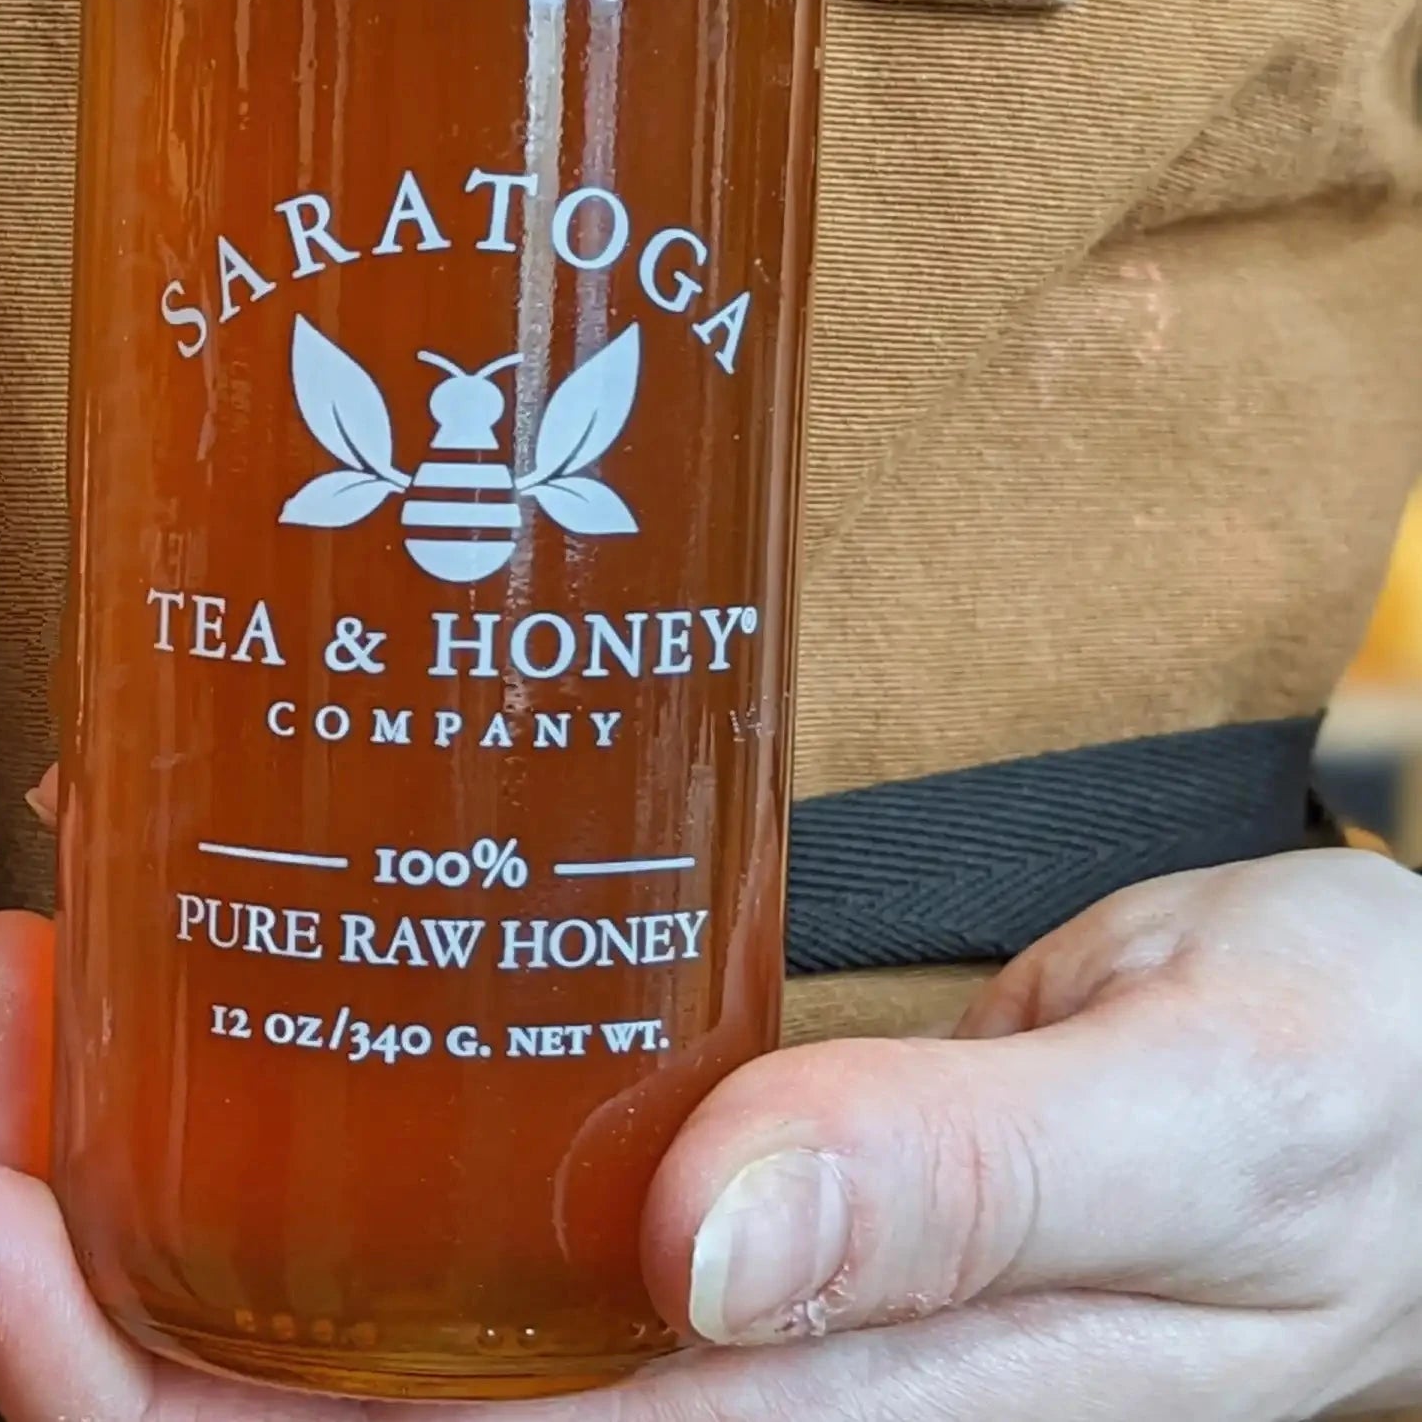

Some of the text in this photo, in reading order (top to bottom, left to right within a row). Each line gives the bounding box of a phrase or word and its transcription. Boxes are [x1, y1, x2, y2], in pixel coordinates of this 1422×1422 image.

[161, 167, 751, 374] SARATOGA
[146, 587, 287, 666] TEA
[323, 615, 387, 675] &
[265, 700, 624, 748] COMPANY
[373, 837, 529, 890] 100%
[177, 892, 709, 971] PURE RAW HONEY
[210, 1004, 670, 1064] 12 OZ/340 G. NET WT.
